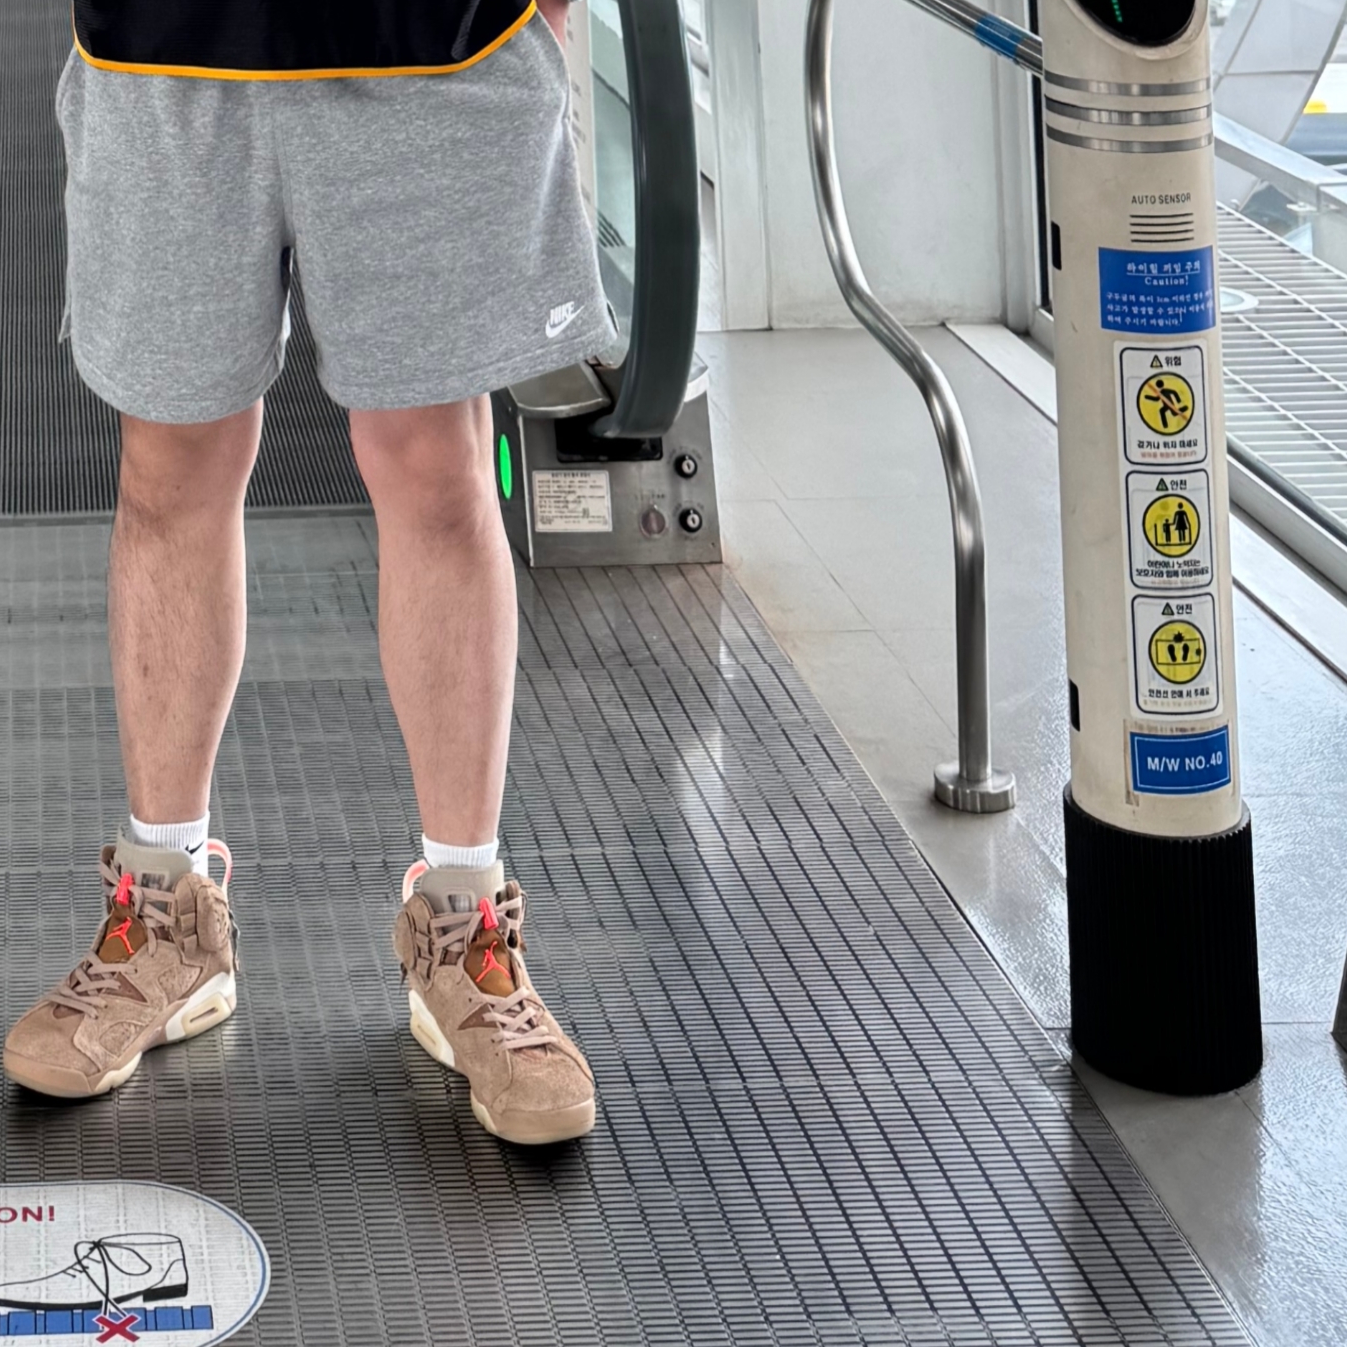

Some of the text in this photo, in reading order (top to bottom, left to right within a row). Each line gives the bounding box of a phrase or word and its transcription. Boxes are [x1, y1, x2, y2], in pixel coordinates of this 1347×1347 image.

[1131, 192, 1191, 205] AUTO SENSOR
[1145, 274, 1189, 286] Caution!
[550, 300, 575, 326] NIKE
[1165, 355, 1182, 367] 위험
[1170, 479, 1187, 491] 안전
[1175, 604, 1193, 615] 안전
[1147, 750, 1223, 772] M/W NO.40
